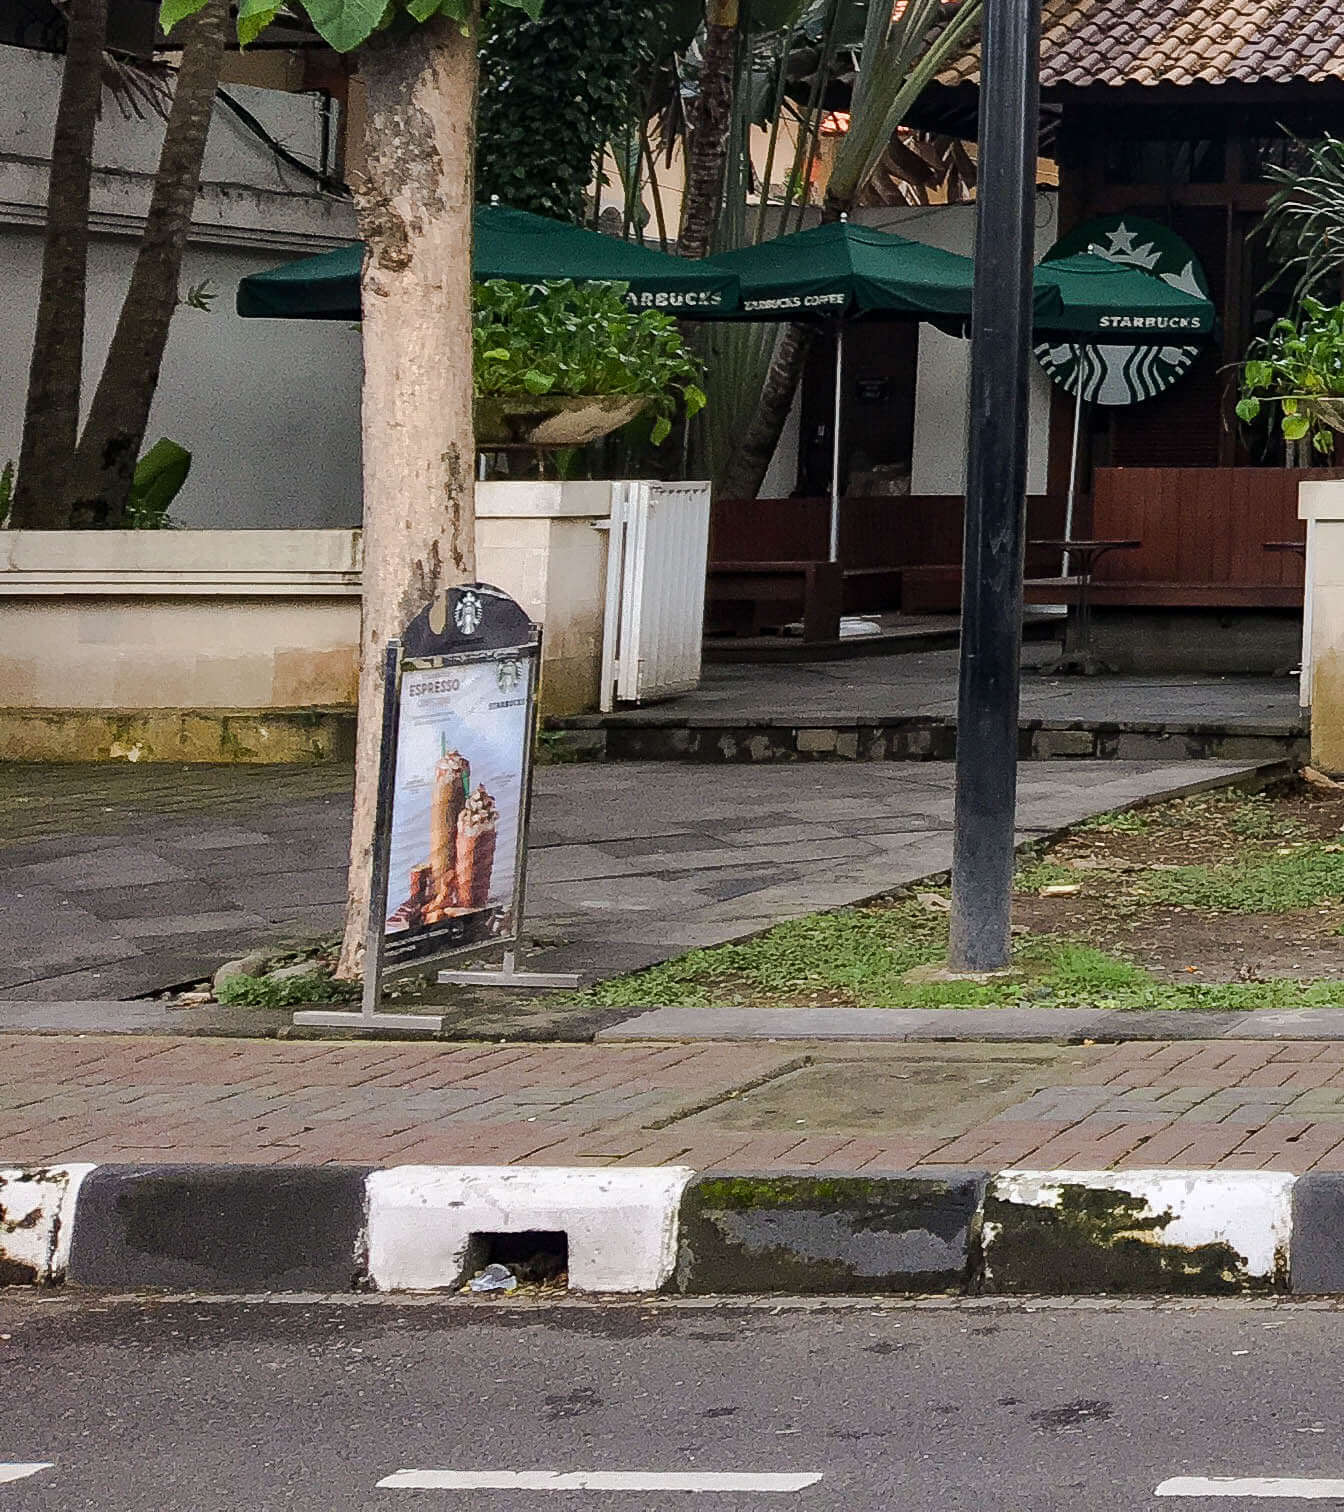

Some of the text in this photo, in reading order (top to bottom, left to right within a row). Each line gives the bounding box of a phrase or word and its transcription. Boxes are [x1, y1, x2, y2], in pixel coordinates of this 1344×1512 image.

[625, 291, 722, 307] ARBUCKS
[1099, 316, 1201, 328] STARBUCKS
[409, 679, 460, 698] ESPRESSO
